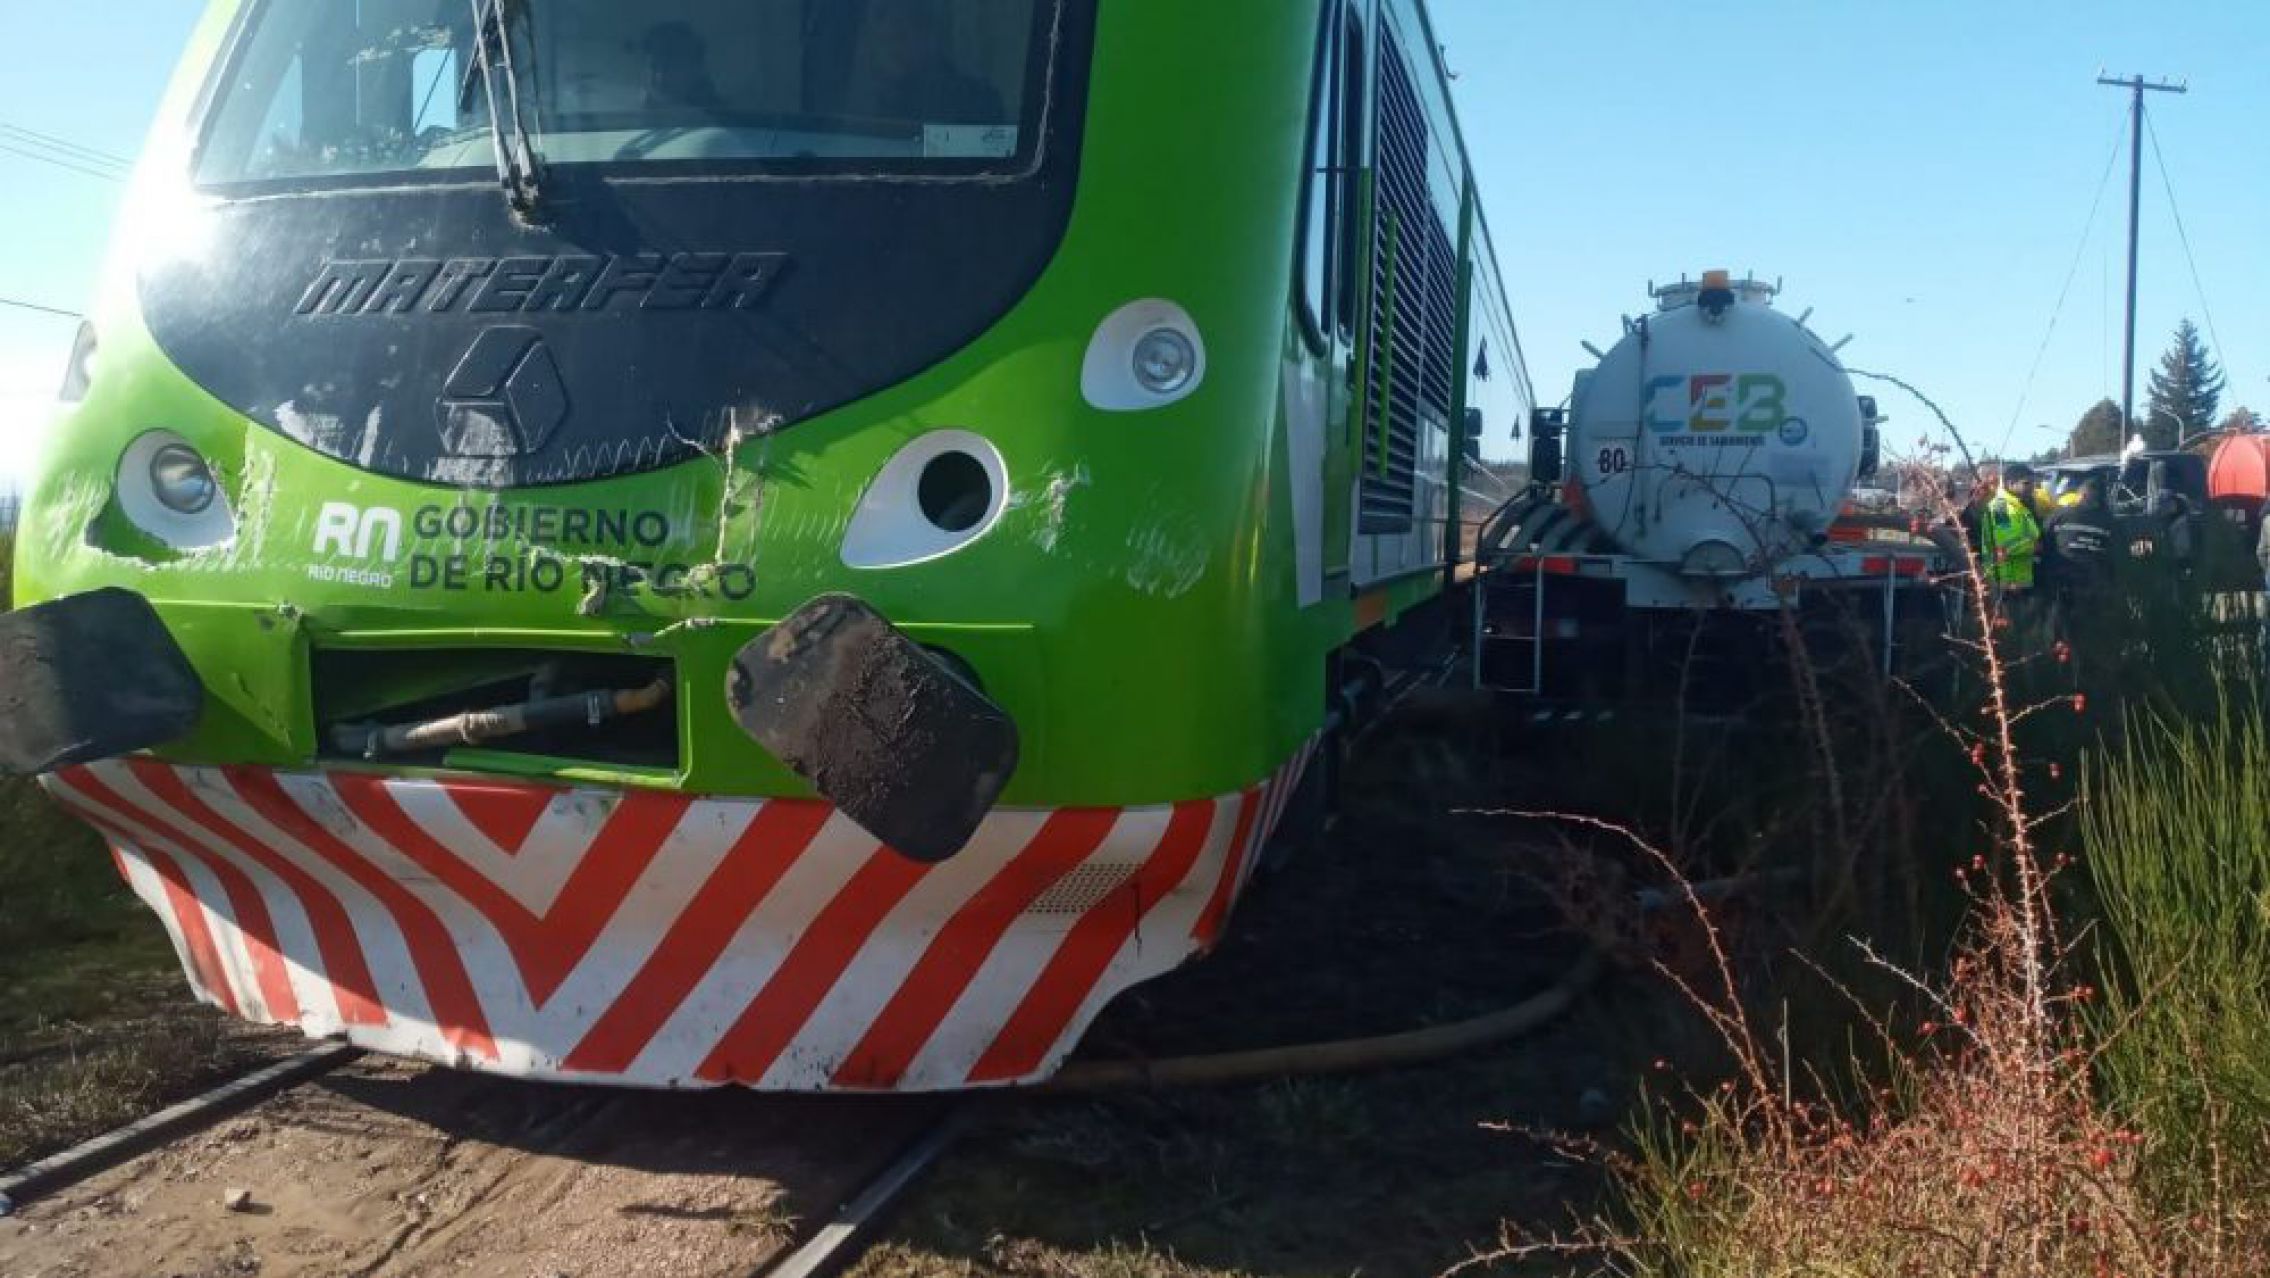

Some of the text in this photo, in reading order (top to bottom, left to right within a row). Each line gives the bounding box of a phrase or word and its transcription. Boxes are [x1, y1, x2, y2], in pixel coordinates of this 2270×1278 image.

[294, 252, 790, 315] MATERFER
[1645, 374, 1787, 433] CEB
[1598, 447, 1625, 474] 80
[413, 504, 669, 547] GOBIERNO
[410, 554, 468, 590] DE
